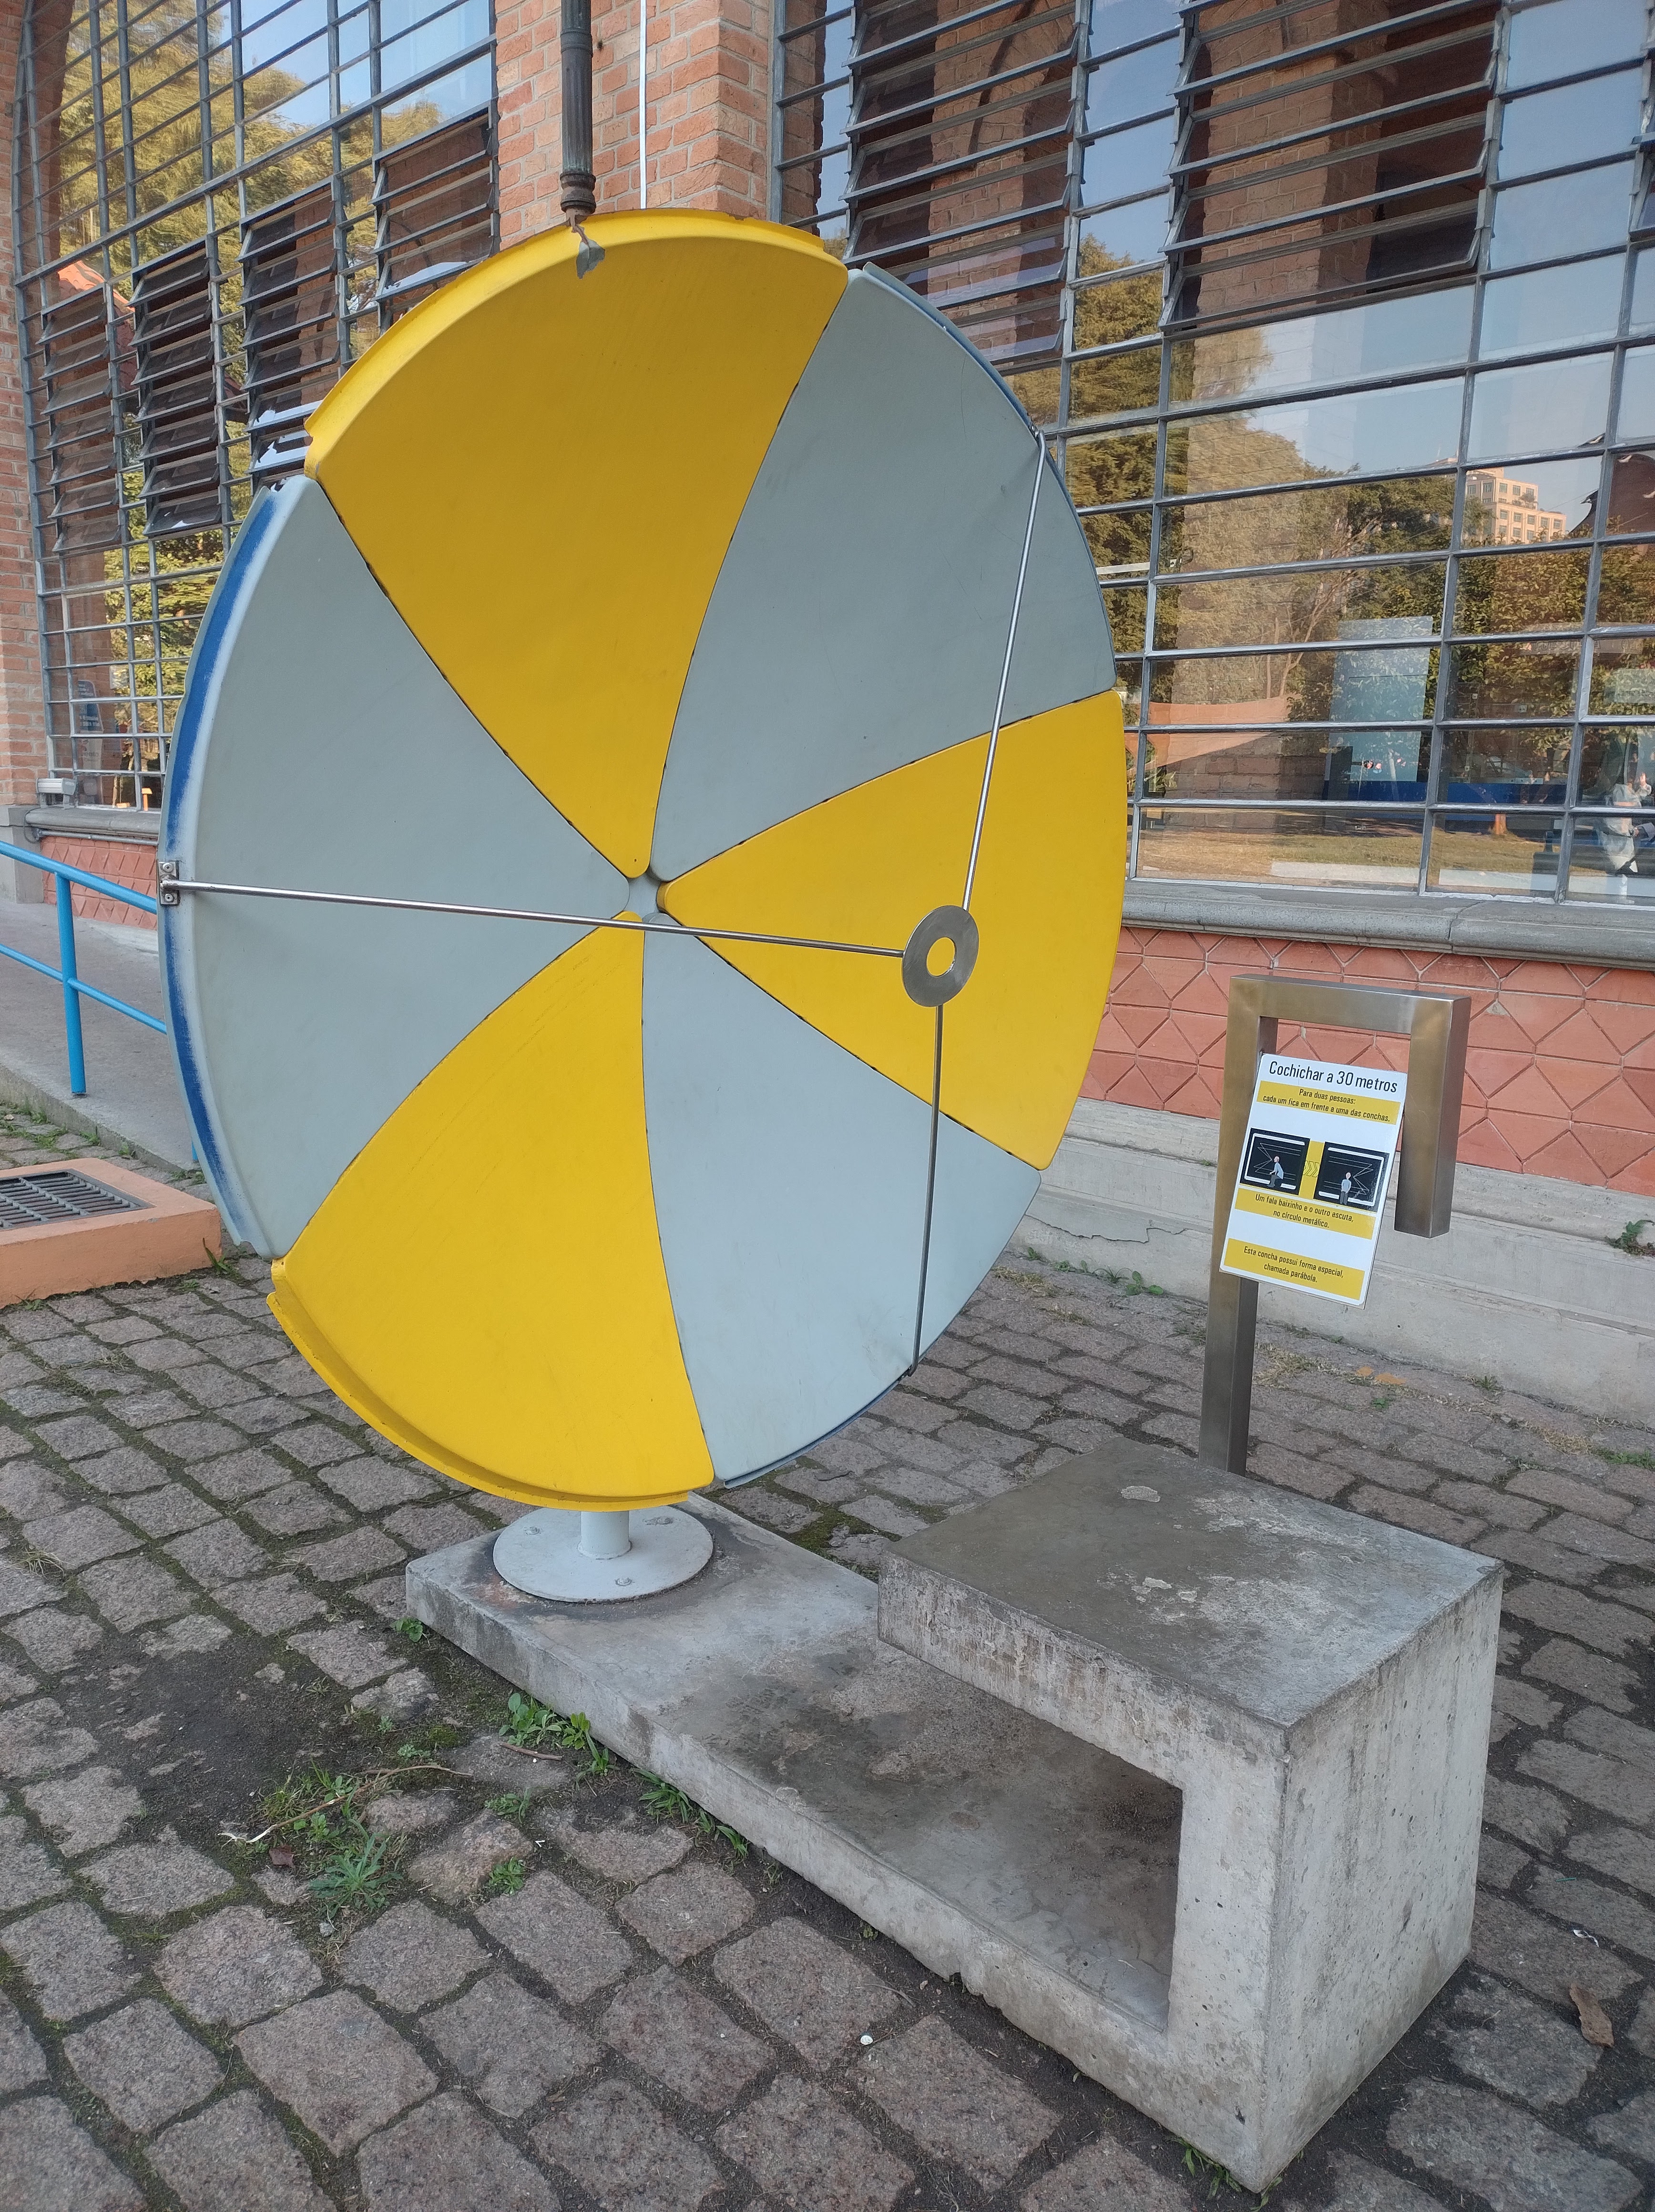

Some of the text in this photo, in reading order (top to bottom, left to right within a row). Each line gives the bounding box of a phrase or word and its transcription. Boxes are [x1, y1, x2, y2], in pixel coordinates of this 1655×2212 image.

[1269, 1061, 1398, 1093] Cochichar a 30 metros
[1299, 1088, 1356, 1104] Para duas pessoas:
[1288, 1098, 1299, 1106] fica
[1311, 1102, 1329, 1111] frente
[1350, 1108, 1361, 1117] das
[1363, 1112, 1390, 1122] conchas.
[1255, 1193, 1265, 1202] Um
[1267, 1196, 1277, 1205] fala
[1278, 1199, 1302, 1210] baixinho
[1314, 1208, 1330, 1217] outro
[1332, 1211, 1354, 1223] escuta,
[1282, 1211, 1301, 1222] círculo
[1302, 1217, 1329, 1228] metálico.
[1244, 1246, 1344, 1278] Esta concha possui forma especial,
[1264, 1263, 1318, 1283] chamada parábola.
